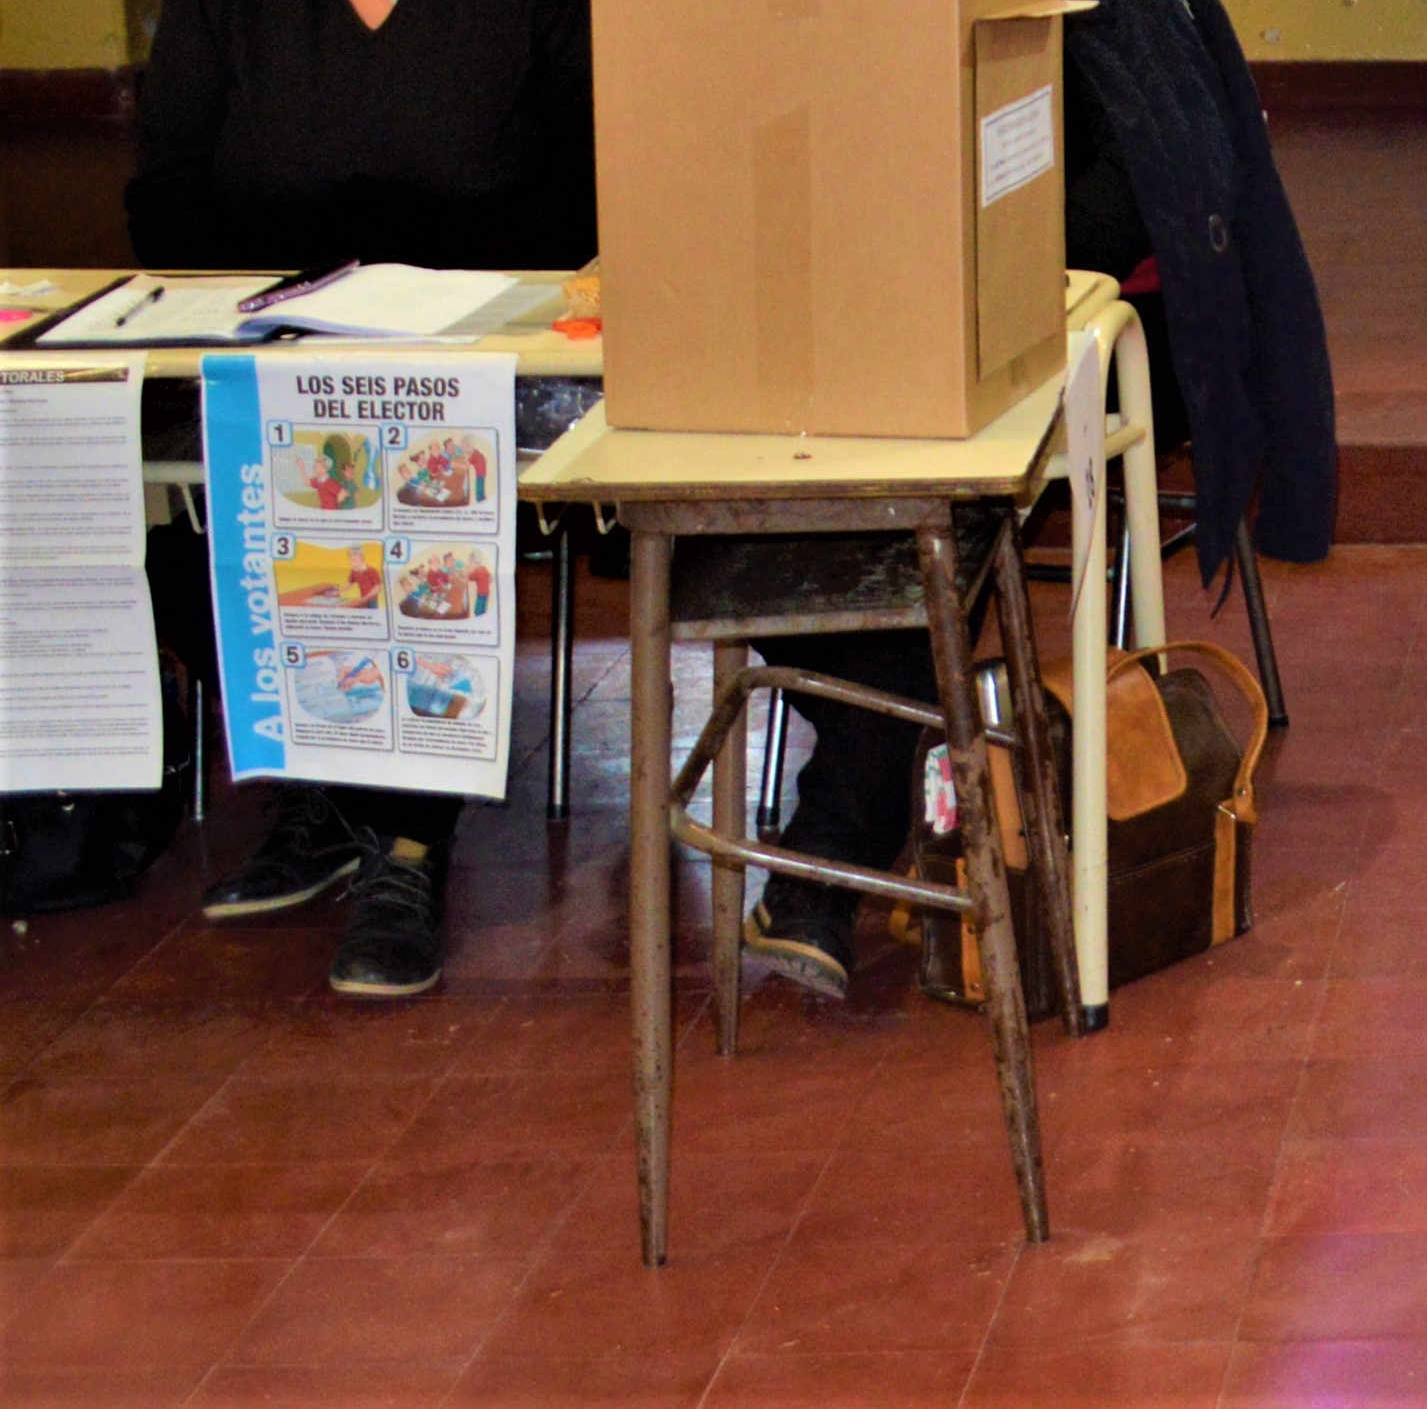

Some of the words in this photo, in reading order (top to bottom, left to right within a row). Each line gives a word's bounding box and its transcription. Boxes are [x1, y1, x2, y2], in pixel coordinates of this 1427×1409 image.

[296, 375, 336, 395] LOS
[341, 376, 387, 397] SEIS
[394, 377, 461, 398] PASOS
[313, 399, 352, 419] DEL
[357, 400, 446, 421] ELECTOR
[273, 424, 284, 442] 1
[387, 426, 401, 445] 2
[236, 463, 276, 636] votantes
[277, 536, 289, 556] 3
[390, 540, 403, 559] 4
[286, 645, 299, 664] 5
[396, 651, 410, 670] 6
[250, 648, 283, 703] los
[252, 716, 286, 742] A
